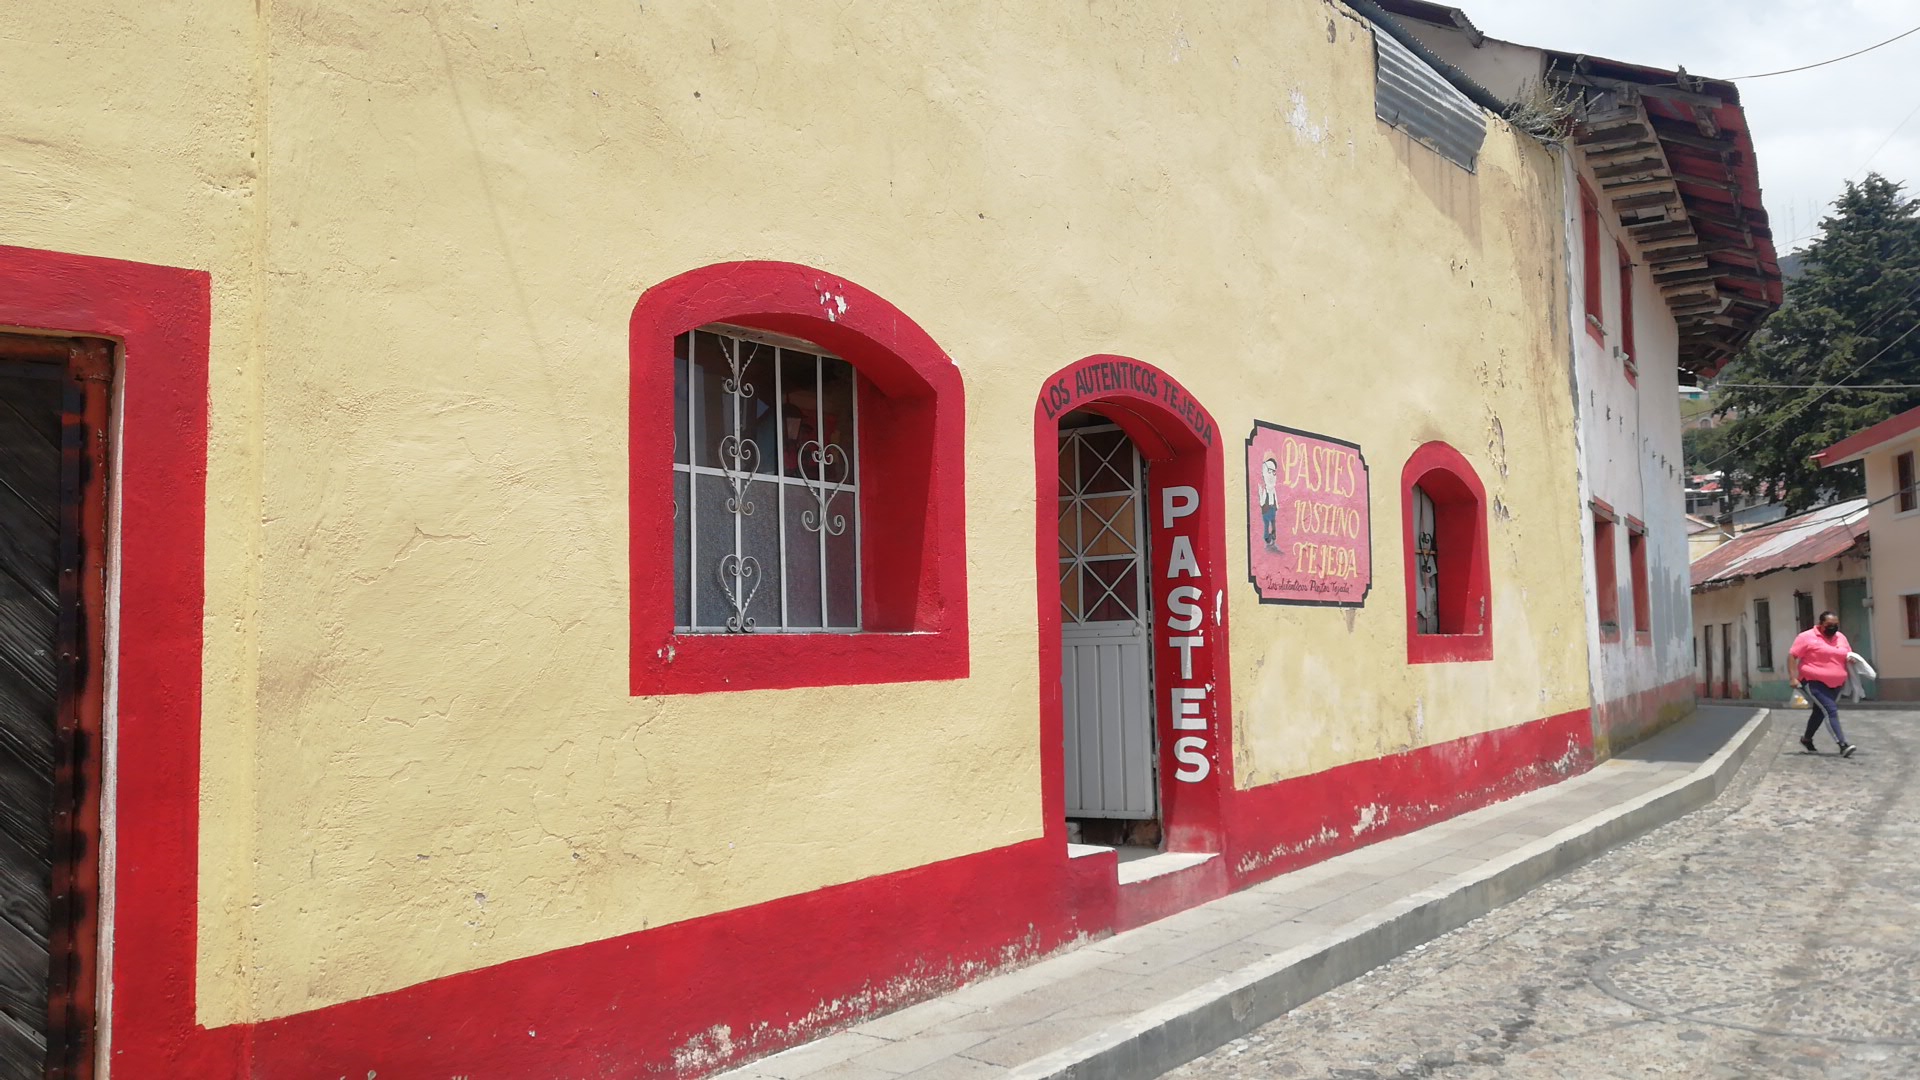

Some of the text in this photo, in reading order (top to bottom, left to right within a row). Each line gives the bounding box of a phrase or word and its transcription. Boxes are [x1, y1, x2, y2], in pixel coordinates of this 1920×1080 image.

[1042, 361, 1213, 446] LOS AUTENTICOS TEJEDA
[1282, 437, 1356, 498] PASTES
[1292, 499, 1360, 539] JUSTINO
[1292, 541, 1358, 580] TEJEDA
[1161, 485, 1211, 783] PASTES
